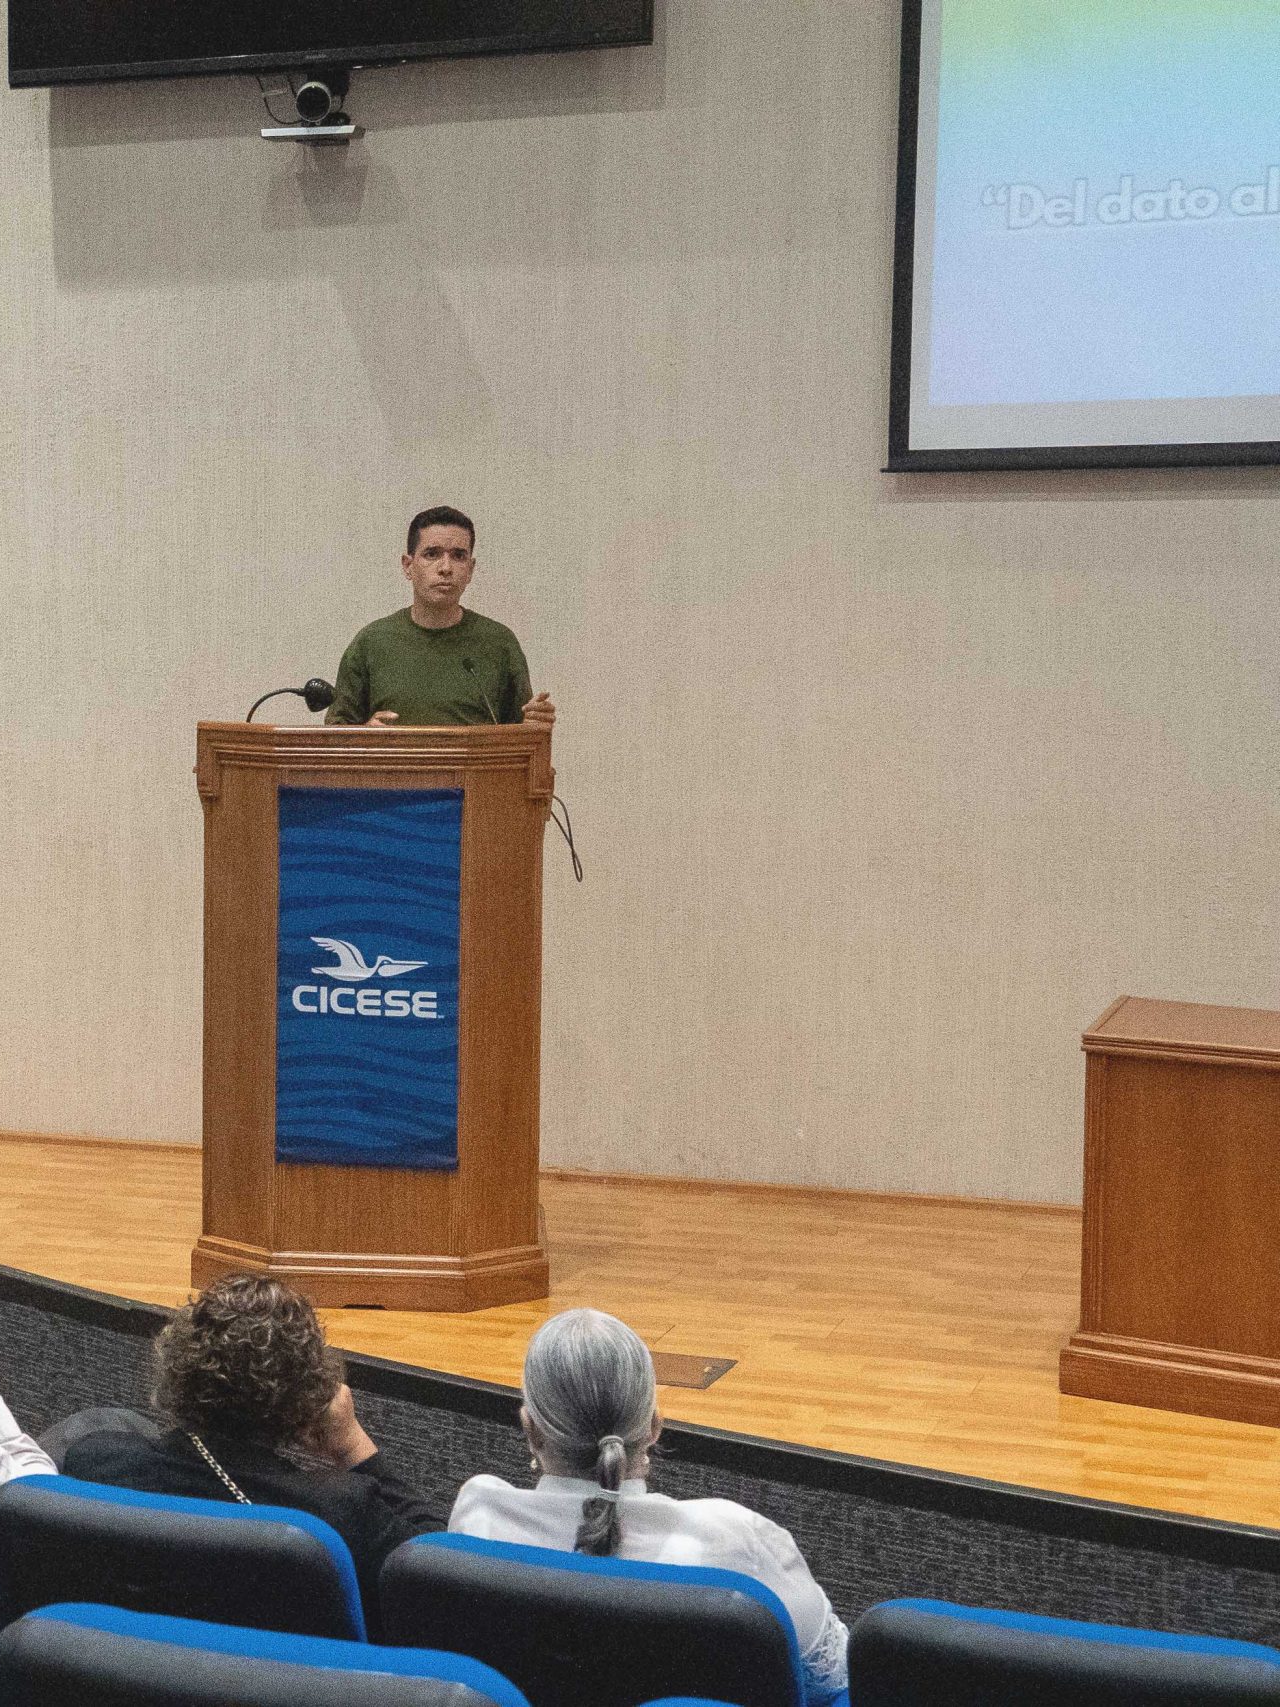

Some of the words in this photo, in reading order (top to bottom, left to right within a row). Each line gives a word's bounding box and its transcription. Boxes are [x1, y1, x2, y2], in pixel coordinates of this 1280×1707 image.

[1096, 175, 1220, 224] dato
[1229, 165, 1280, 216] al
[292, 985, 438, 1019] CICESE
